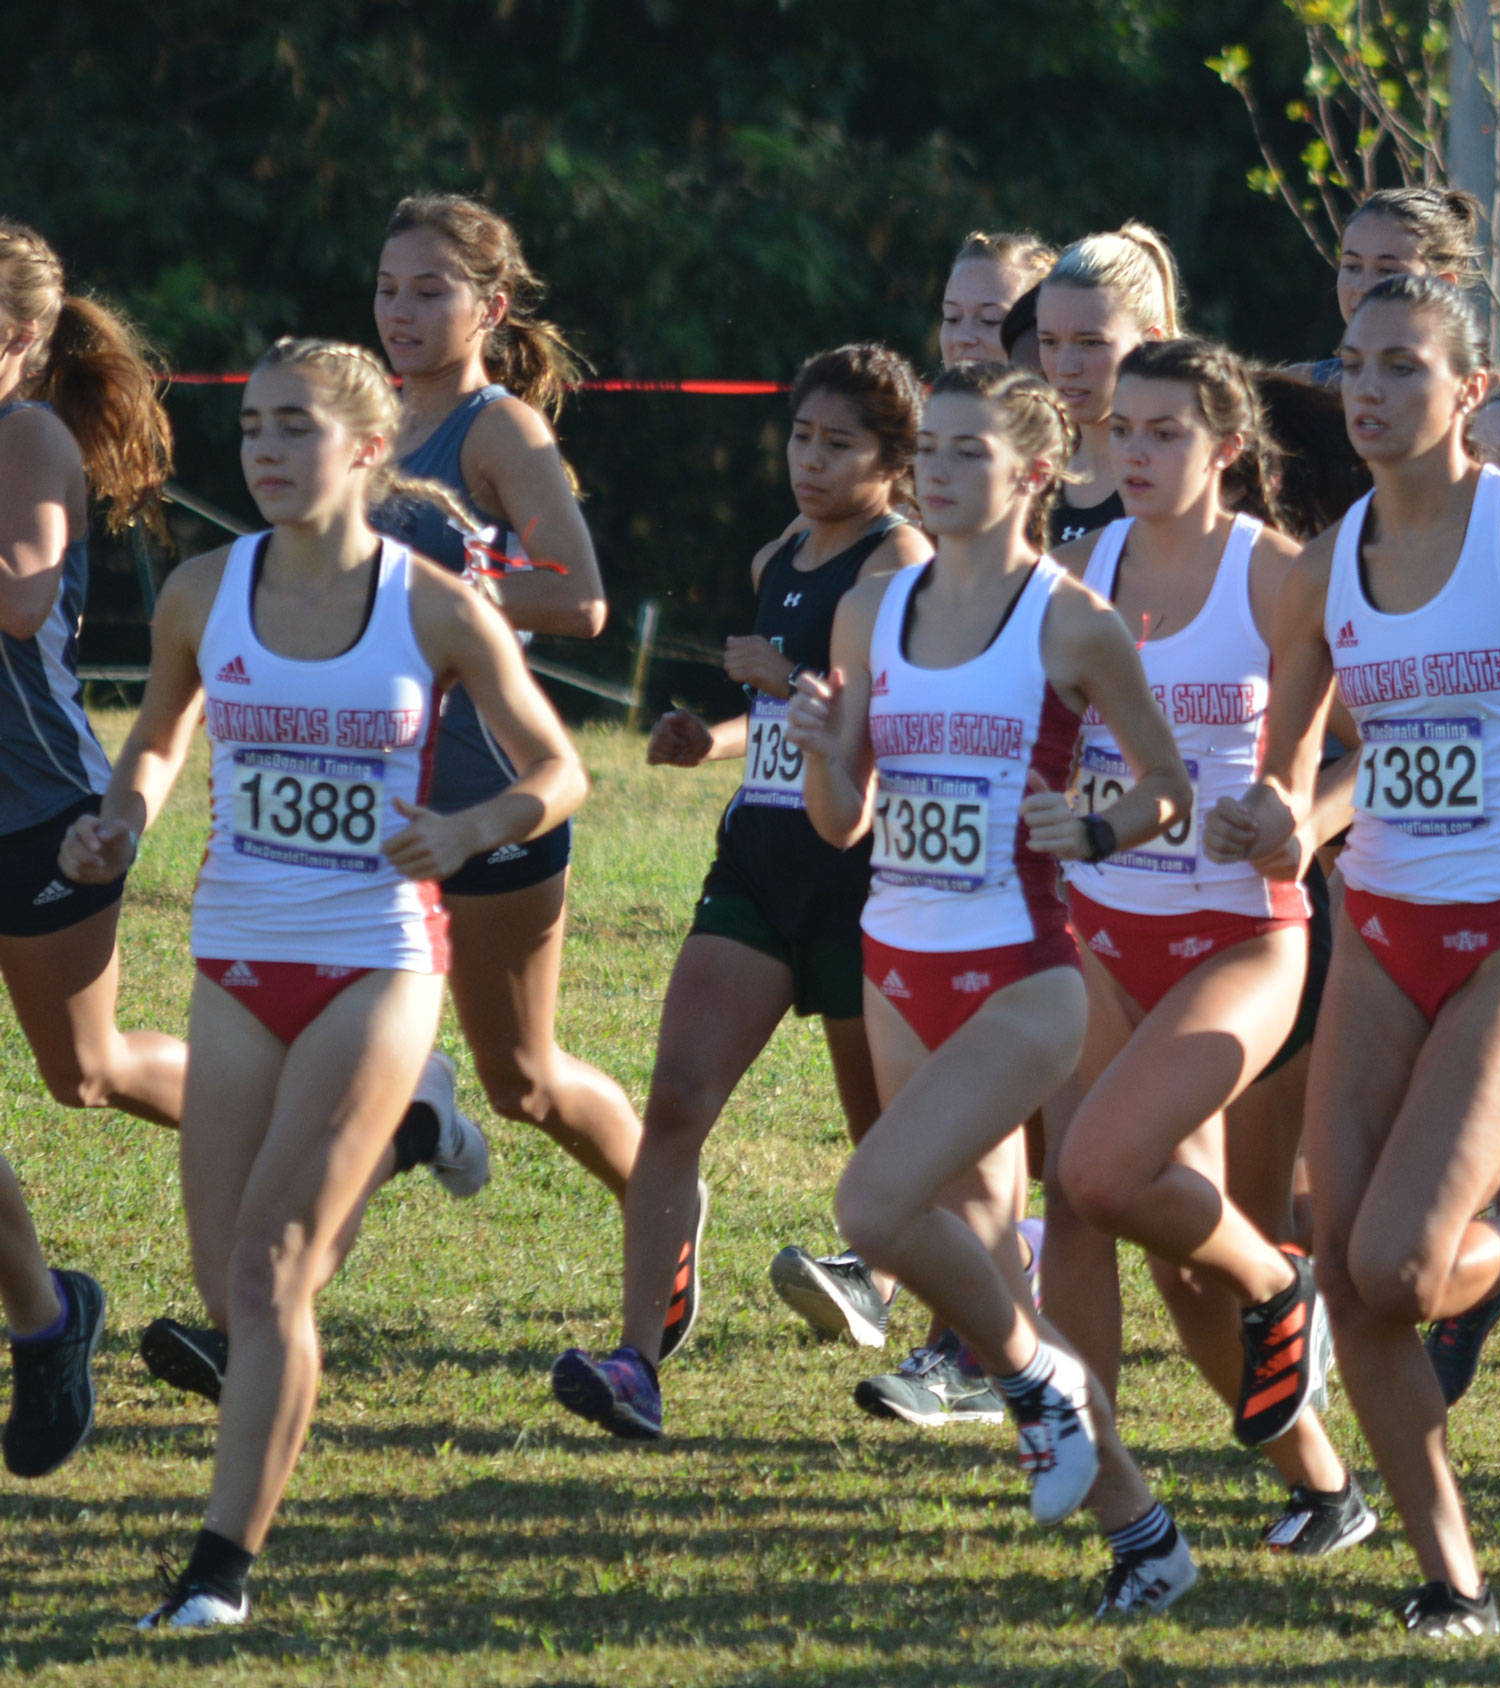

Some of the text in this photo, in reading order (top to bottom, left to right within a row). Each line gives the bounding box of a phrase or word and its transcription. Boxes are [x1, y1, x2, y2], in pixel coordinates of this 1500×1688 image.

[1173, 684, 1255, 725] STATE
[1335, 657, 1421, 708] KANSAS
[336, 708, 421, 749] STATE
[950, 713, 1022, 760] STATE
[1424, 722, 1468, 741] Timing
[243, 751, 371, 779] MacDonald Timing
[751, 723, 804, 782] 139
[931, 778, 977, 797] Timing
[1364, 745, 1479, 809] 1382
[240, 772, 376, 845] 1388
[876, 798, 981, 867] 1385
